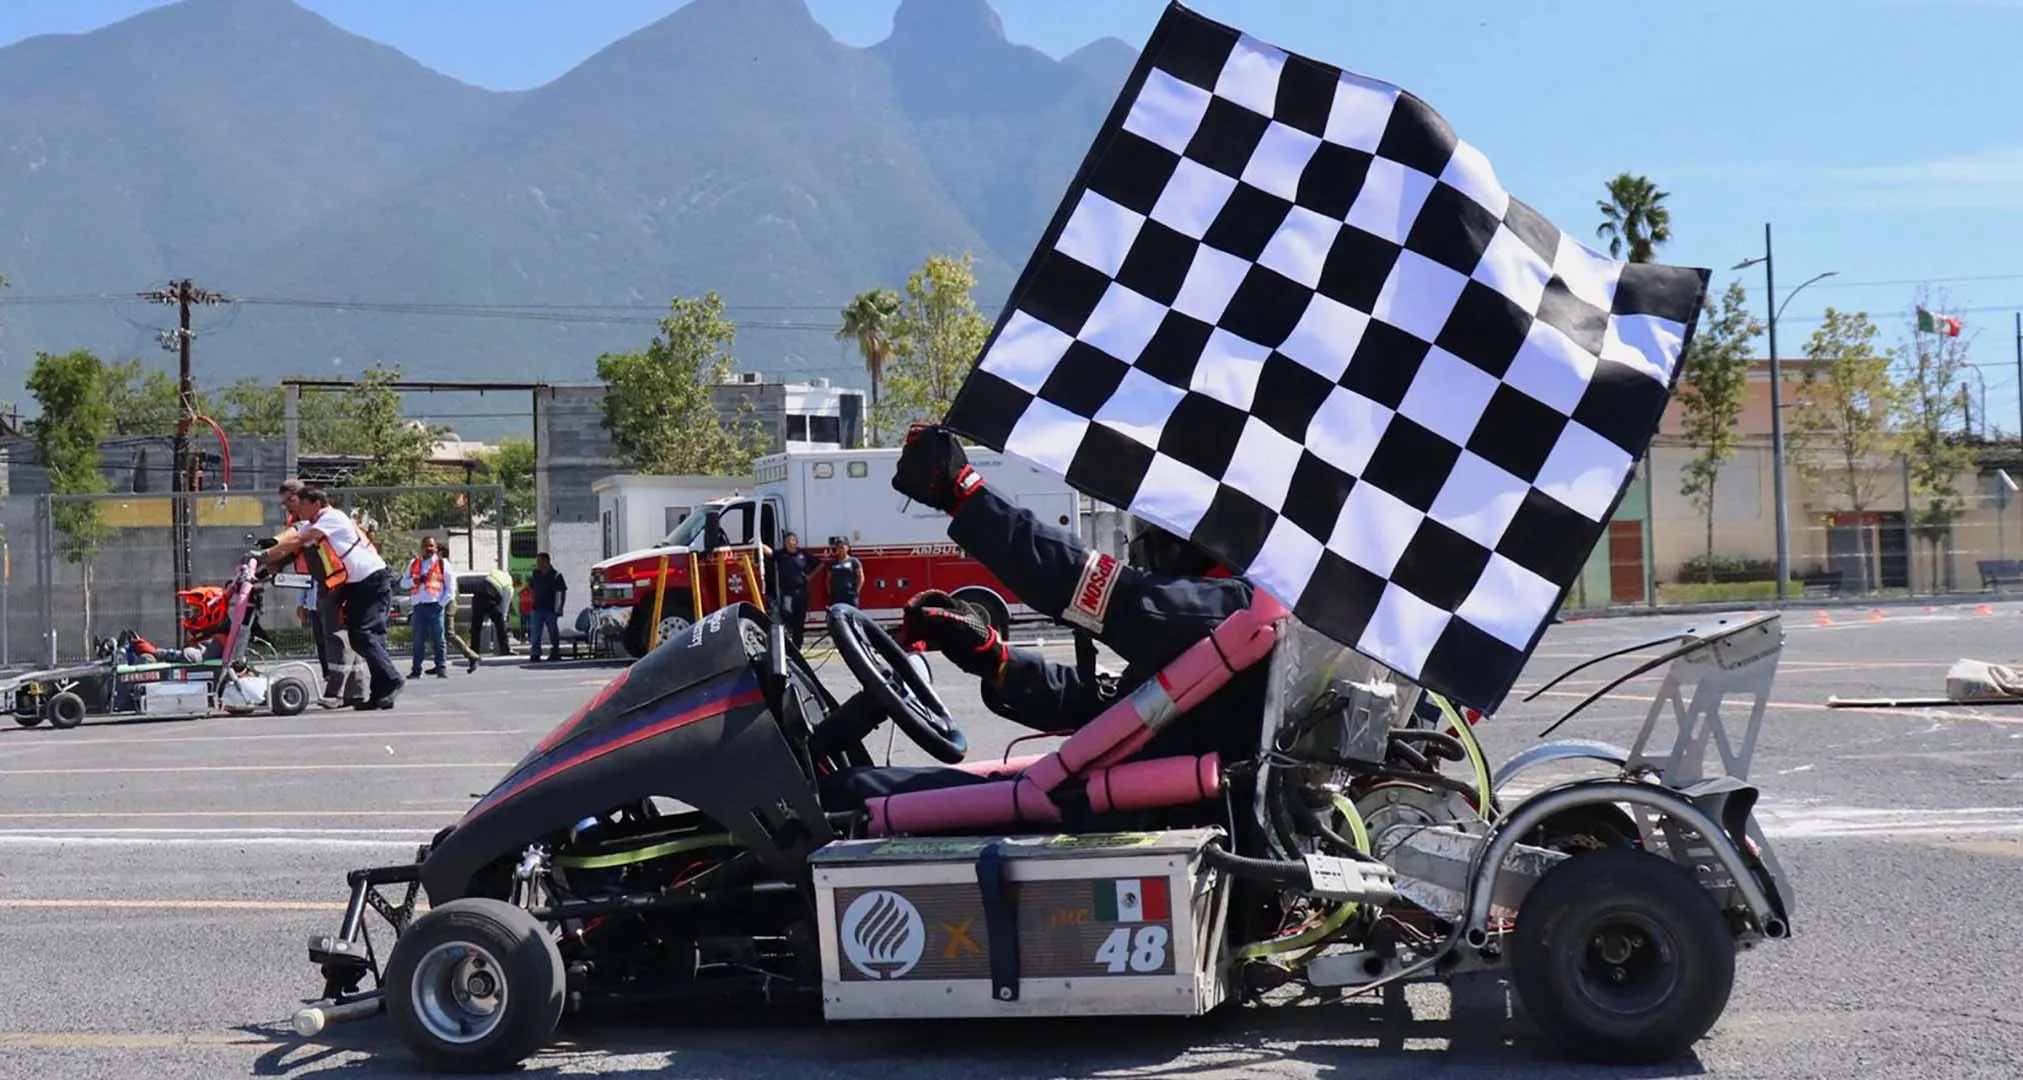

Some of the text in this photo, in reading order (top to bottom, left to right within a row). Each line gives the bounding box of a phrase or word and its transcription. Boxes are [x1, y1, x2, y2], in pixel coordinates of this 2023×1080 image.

[911, 544, 961, 556] AMBUL
[1080, 552, 1118, 611] MPSON
[1094, 925, 1168, 973] 48
